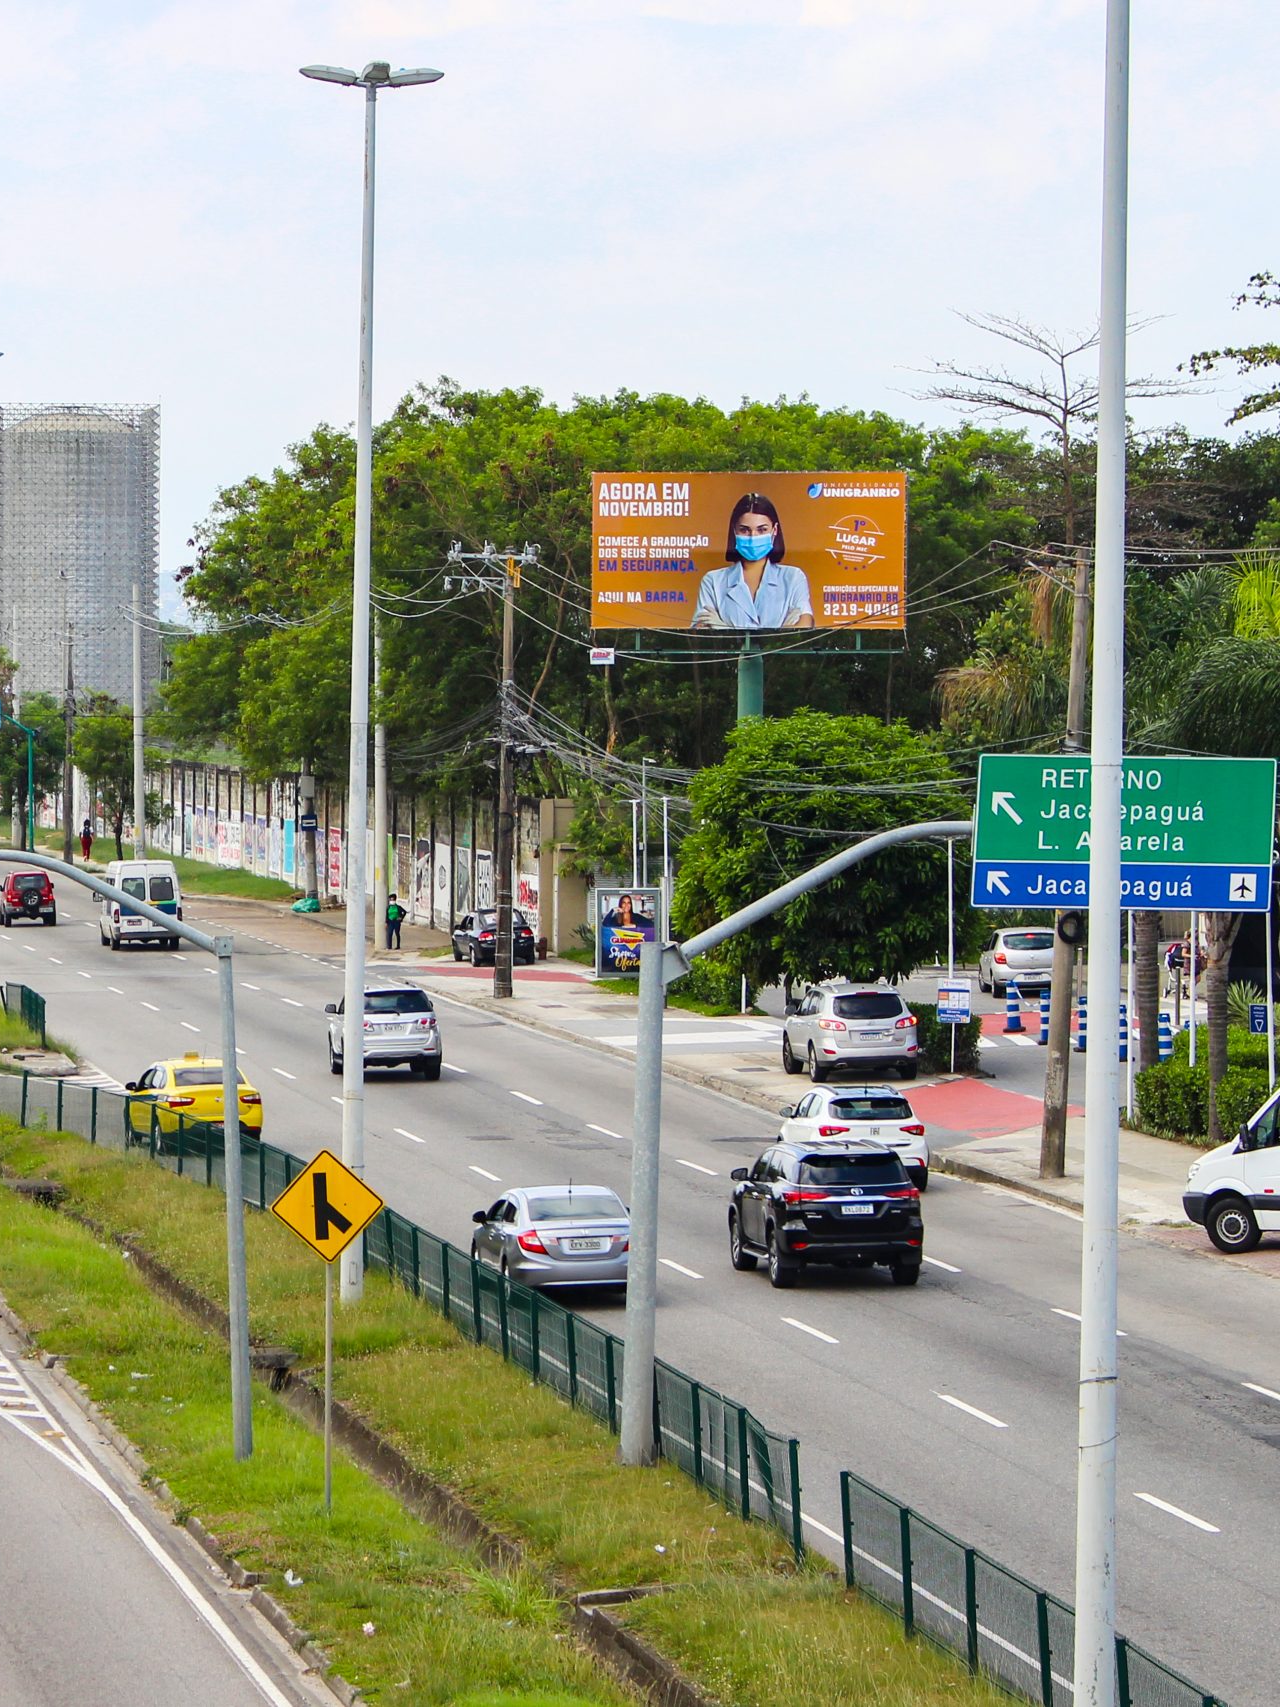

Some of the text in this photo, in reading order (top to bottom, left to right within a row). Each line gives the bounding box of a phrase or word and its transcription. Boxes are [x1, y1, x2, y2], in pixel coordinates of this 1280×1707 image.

[599, 482, 689, 500] AGORA EM
[823, 488, 900, 498] UNIGRANRIO
[599, 501, 689, 517] NOVEMBRO!
[854, 519, 866, 532] 1º
[598, 534, 709, 549] COMECE A GRADUAÇÃO
[835, 532, 876, 547] LUGAR
[598, 548, 690, 558] DOS SEUS SONHOS
[598, 560, 699, 574] EM SEGURANÇA.
[823, 584, 857, 593] CONDIÇÕES
[598, 591, 688, 603] AQUI NA BARRA.
[823, 592, 898, 602] UNIGRANRIO.BR
[823, 603, 899, 616] 3219-4040
[1041, 768, 1162, 790] RETNO
[1040, 799, 1204, 825] Jacepaguá
[1038, 831, 1185, 852] L. Aarela
[1027, 875, 1193, 901] Jacapaguá
